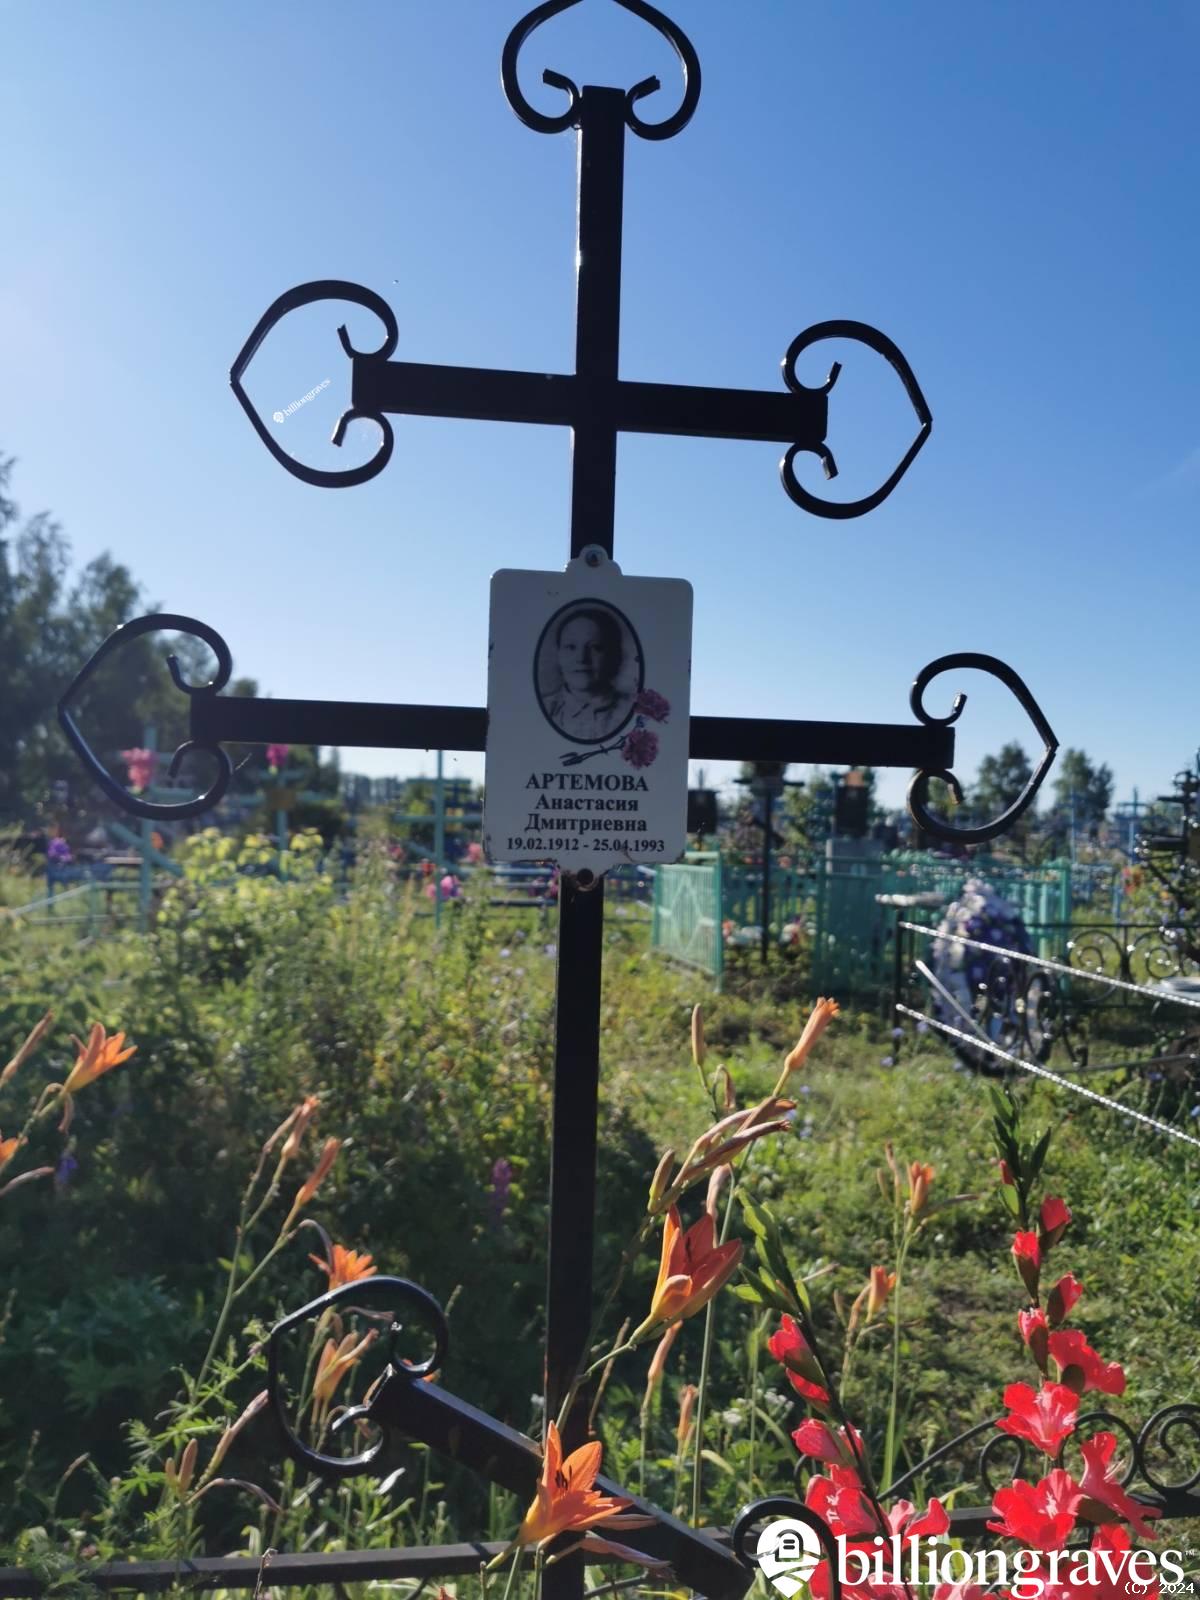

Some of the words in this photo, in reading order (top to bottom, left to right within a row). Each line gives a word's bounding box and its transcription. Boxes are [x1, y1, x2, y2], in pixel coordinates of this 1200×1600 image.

[526, 773, 649, 792] АРТЕМОВА
[535, 794, 639, 812] Анастасия
[524, 813, 648, 835] Дмитриевна
[507, 837, 580, 850] 19.02.1912
[593, 839, 665, 852] 25.04.1993
